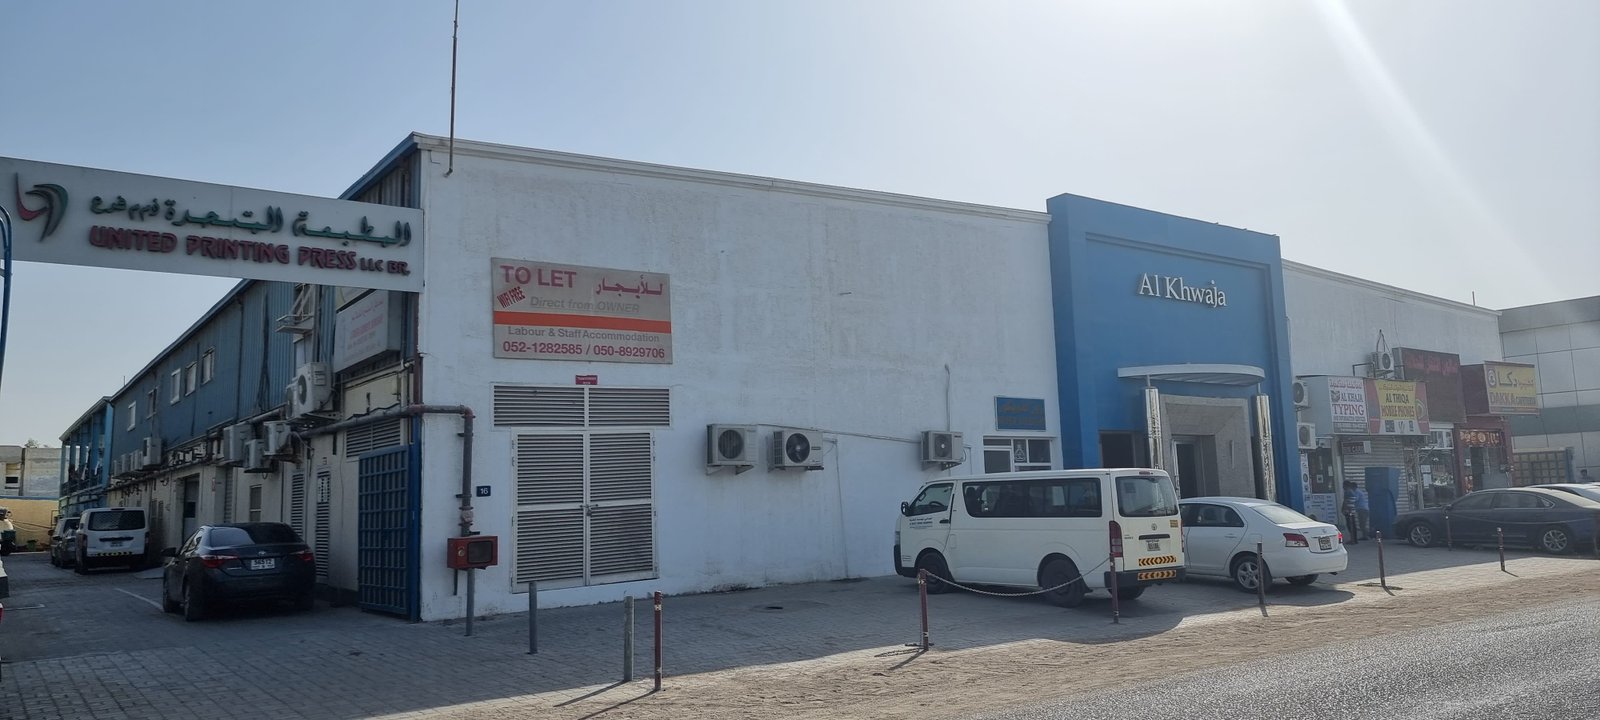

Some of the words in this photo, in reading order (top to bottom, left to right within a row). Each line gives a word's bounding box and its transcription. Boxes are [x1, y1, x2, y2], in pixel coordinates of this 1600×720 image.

[89, 226, 178, 253] UNITED
[186, 235, 290, 265] PRINTING
[298, 246, 357, 270] PRESS
[500, 265, 531, 285] TO
[537, 268, 577, 288] LET
[1139, 272, 1161, 297] Al
[1164, 276, 1227, 308] Khwaja
[530, 296, 565, 308] Direct
[568, 299, 593, 310] from
[598, 301, 640, 313] OWNER
[508, 326, 545, 337] Labour
[548, 327, 556, 337] &
[558, 328, 582, 339] Staff
[583, 329, 660, 342] Accommodation
[503, 341, 583, 355] 052-1282585
[593, 344, 665, 359] 050-8929706
[1331, 403, 1365, 416] TYPING
